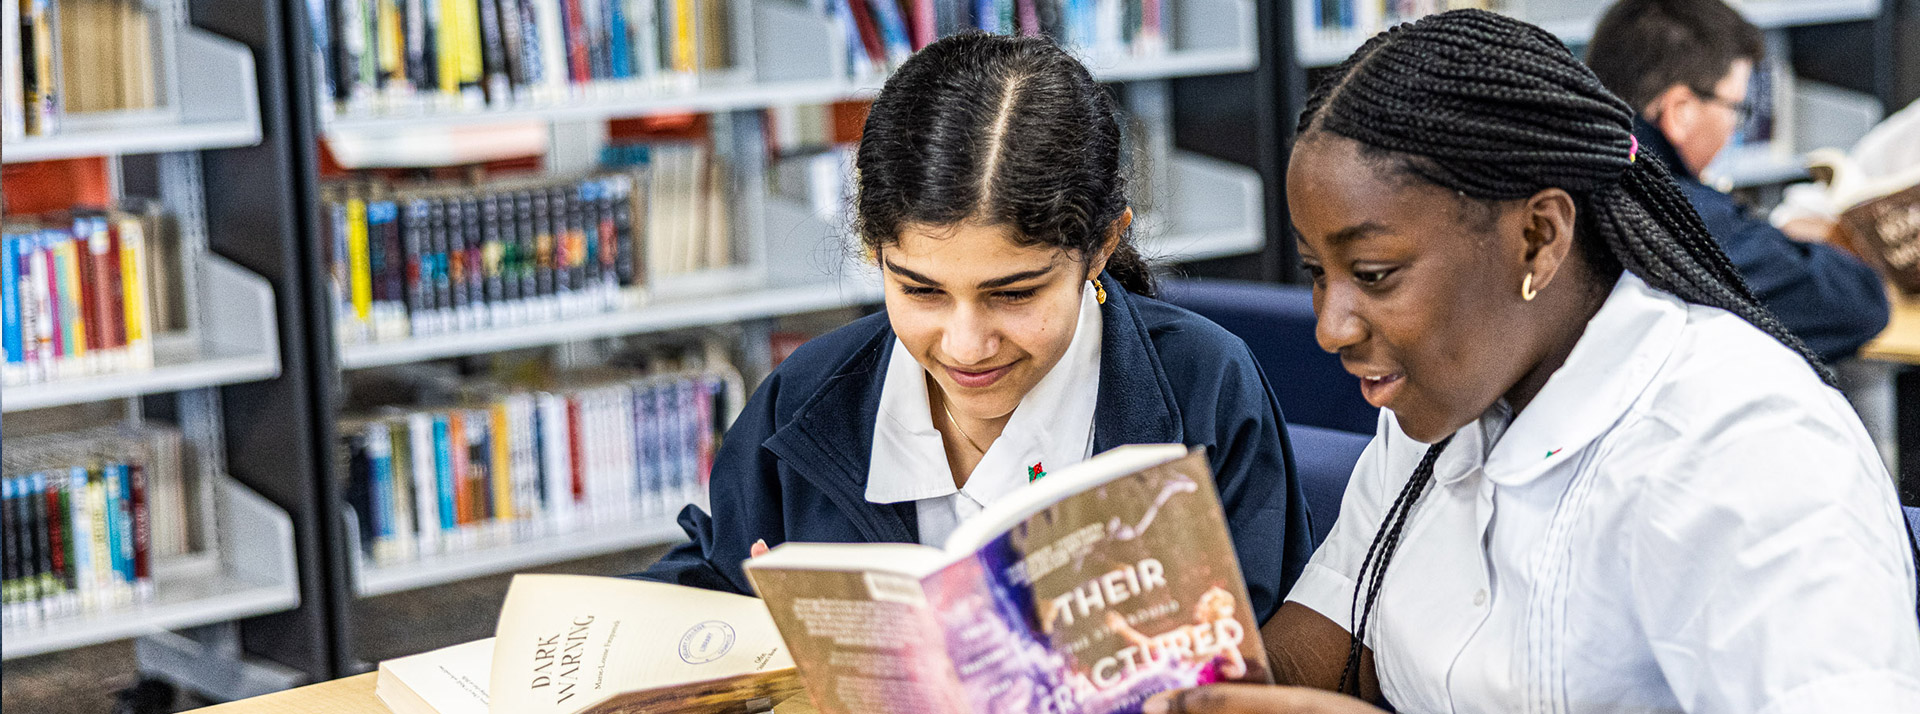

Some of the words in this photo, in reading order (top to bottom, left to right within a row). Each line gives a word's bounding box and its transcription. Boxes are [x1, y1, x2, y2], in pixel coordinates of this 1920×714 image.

[1053, 558, 1167, 626] THEIR
[531, 633, 560, 691] DARK
[557, 615, 595, 705] WARNING
[1040, 617, 1245, 714] FRACTURED
